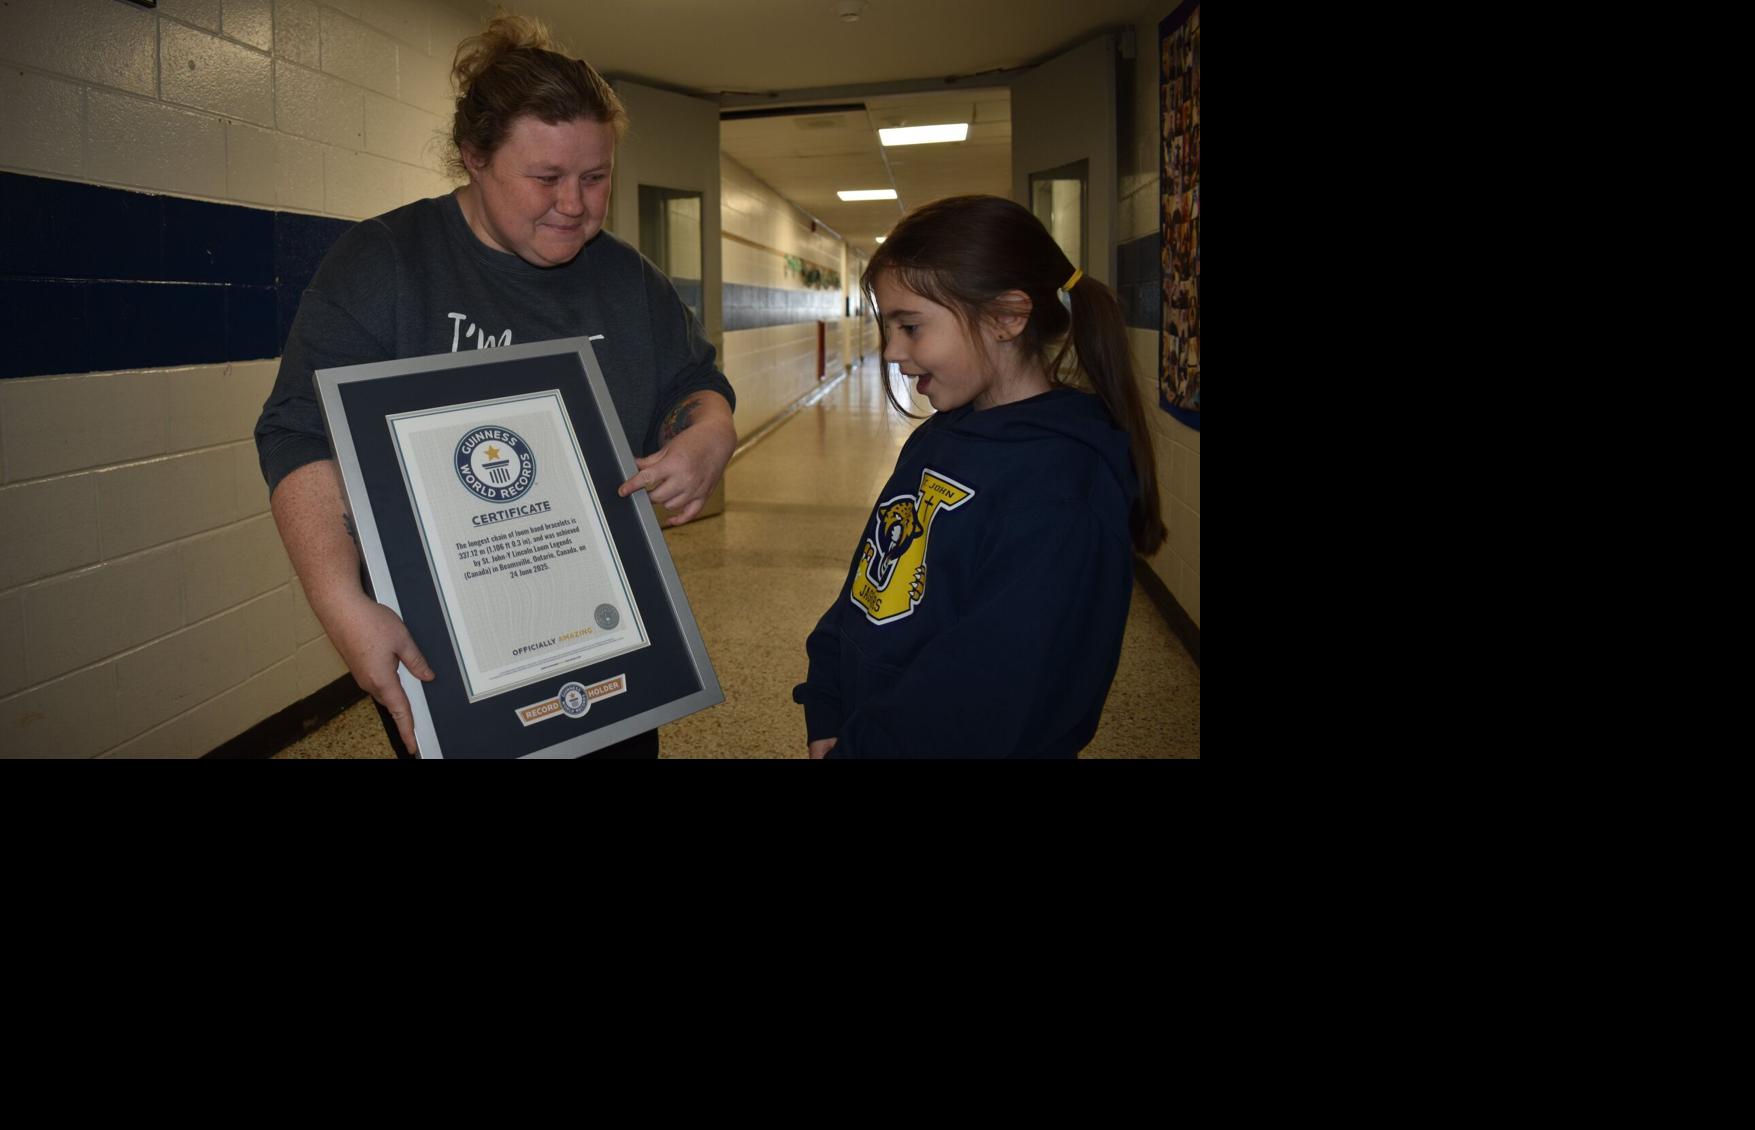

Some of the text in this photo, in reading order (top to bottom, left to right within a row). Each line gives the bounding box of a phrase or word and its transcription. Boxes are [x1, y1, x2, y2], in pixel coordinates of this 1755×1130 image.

[461, 430, 518, 454] GUINNESS
[460, 453, 532, 498] WORLD RECORDS
[928, 482, 956, 498] JOHN
[472, 500, 552, 526] CERTIFICATE
[456, 542, 467, 550] The
[468, 537, 490, 547] longest
[491, 533, 507, 542] chain
[530, 524, 544, 533] band
[544, 519, 571, 530] bracelets
[459, 550, 478, 560] 337.12
[505, 542, 511, 550] ft
[511, 539, 521, 547] 0.3
[533, 534, 544, 542] and
[556, 525, 580, 537] achieved
[511, 547, 534, 558] Lincoln
[533, 544, 550, 552] Loom
[549, 538, 573, 549] Legends
[464, 566, 492, 581] (Canada)
[510, 570, 519, 579] 24
[519, 569, 532, 577] June
[512, 627, 593, 656] OFFICIALLY AMAZING
[525, 702, 559, 719] RECORD
[588, 681, 619, 698] HOLDER
